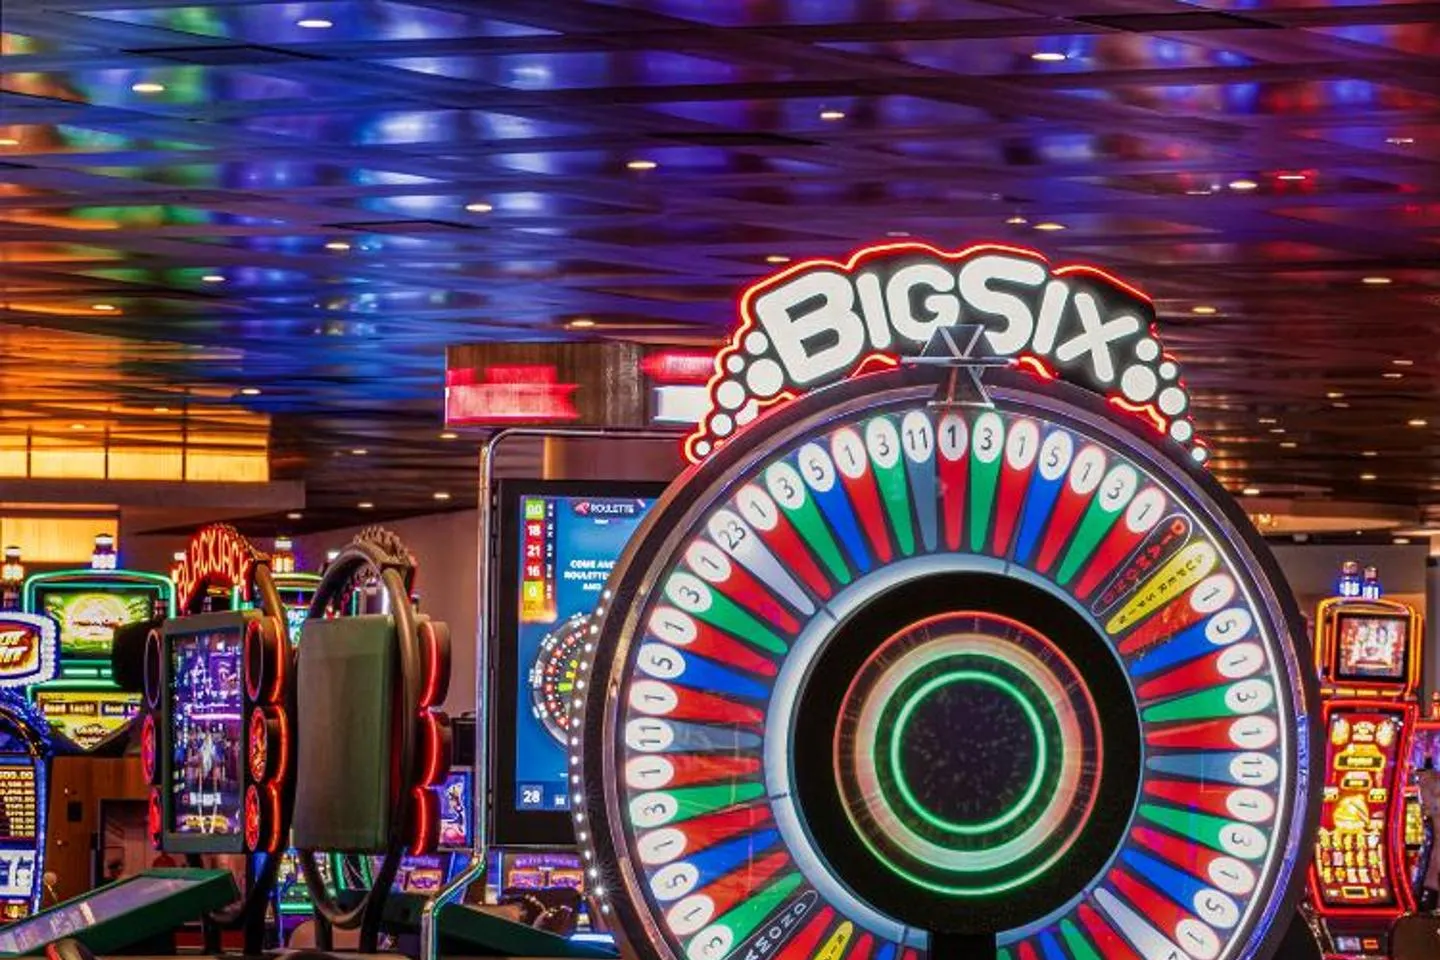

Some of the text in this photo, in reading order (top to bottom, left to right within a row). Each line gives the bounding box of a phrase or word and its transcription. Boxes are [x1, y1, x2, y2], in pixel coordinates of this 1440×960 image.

[756, 256, 1140, 384] BIG SIX
[877, 434, 889, 457] 3
[906, 427, 928, 451] 11
[947, 428, 956, 447] 1
[980, 427, 993, 451] 3
[1019, 436, 1025, 458] 1
[844, 445, 856, 466] 1
[1046, 446, 1060, 468] 5
[809, 458, 824, 481] 5
[1081, 462, 1092, 482] 1
[778, 477, 795, 500] 3
[1107, 480, 1124, 500] 3
[590, 504, 635, 514] ROULETTE
[751, 501, 766, 518] 1
[1138, 504, 1152, 521] 1
[527, 544, 541, 557] 21
[177, 527, 249, 611] BLACKJACK
[701, 556, 719, 570] 1
[679, 586, 701, 604] 3
[1202, 587, 1220, 602] 1
[664, 621, 685, 632] 1
[1216, 619, 1237, 634] 5
[651, 656, 673, 670] 5
[1229, 656, 1248, 666] 1
[1236, 690, 1257, 703] 3
[639, 726, 661, 747] 11
[1241, 728, 1261, 736] 1
[638, 769, 661, 777] 1
[1242, 758, 1262, 778] 11
[523, 790, 541, 803] 28
[643, 803, 666, 816] 3
[653, 840, 673, 851] 1
[1231, 832, 1251, 847] 3
[666, 873, 687, 889] 5
[1219, 869, 1239, 881] 1
[683, 907, 702, 921] 1
[1205, 898, 1224, 914] 5
[703, 936, 723, 955] 3
[1187, 931, 1204, 945] 1
